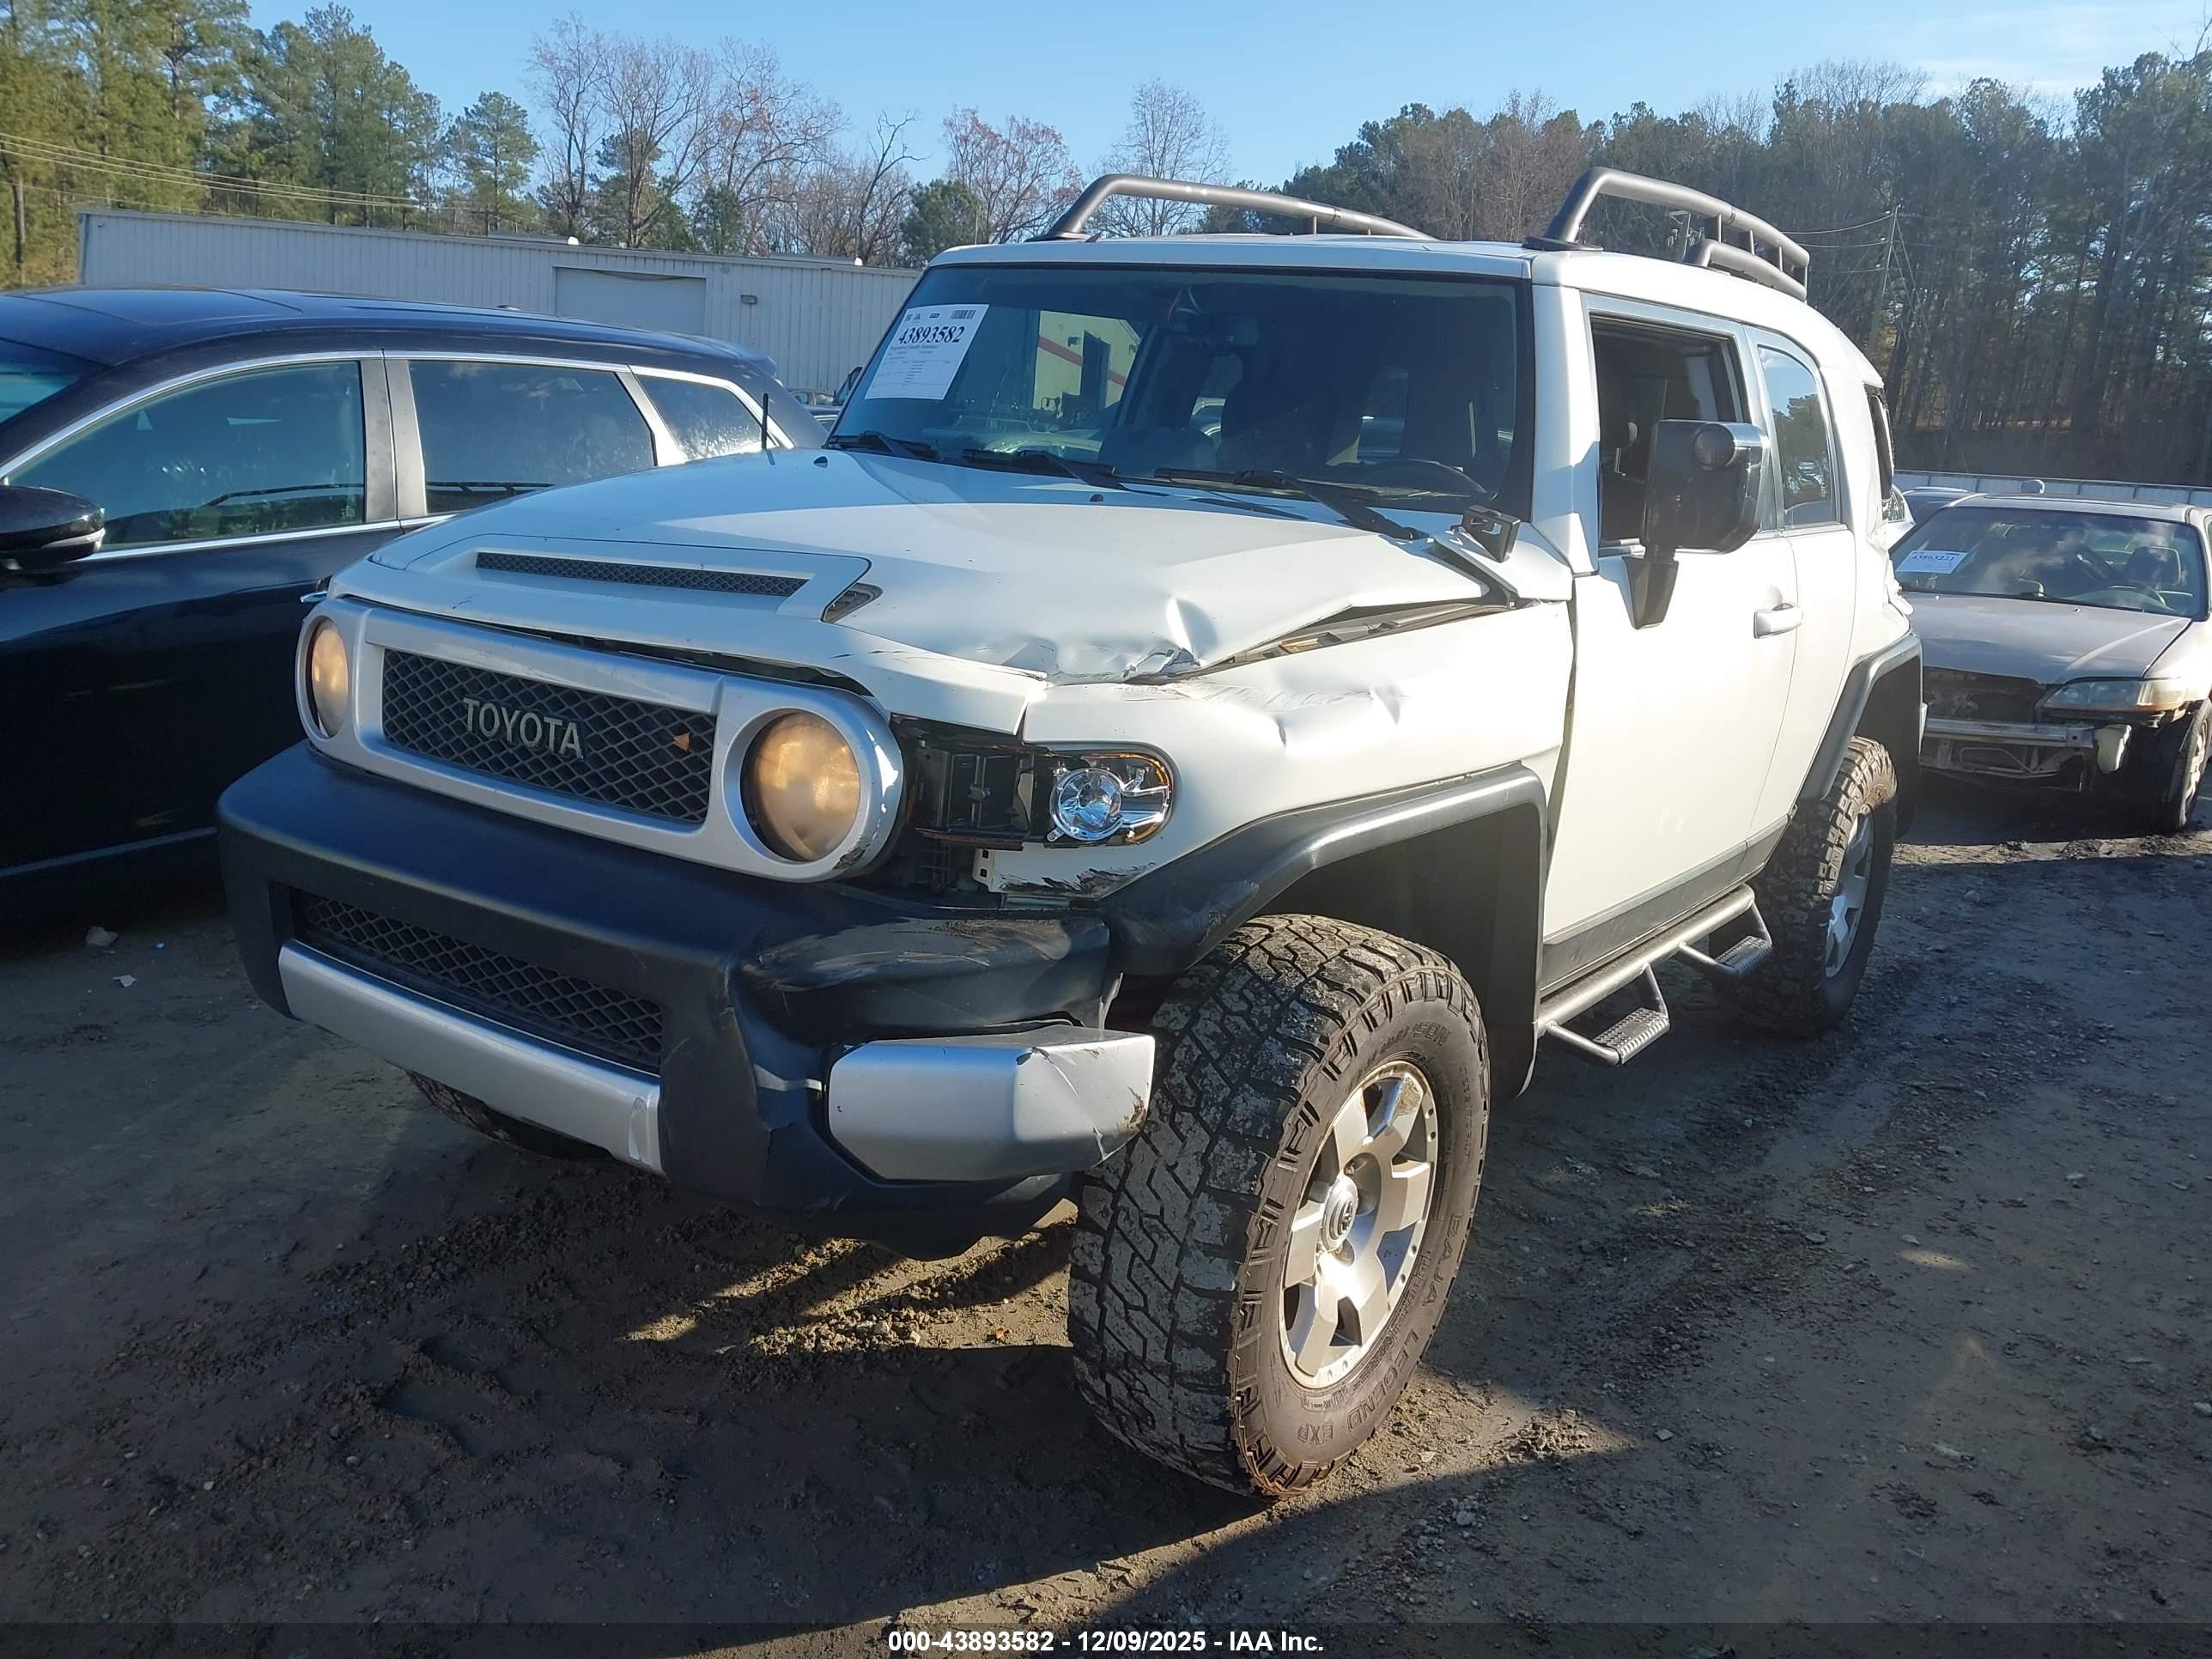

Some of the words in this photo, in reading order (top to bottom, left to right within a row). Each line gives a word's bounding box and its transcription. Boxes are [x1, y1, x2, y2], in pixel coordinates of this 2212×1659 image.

[898, 325, 965, 344] 43893582
[462, 696, 584, 761] TOYOTA
[1422, 1213, 1462, 1307] BAJA
[1346, 1328, 1419, 1433] LEGEND
[1297, 1422, 1334, 1446] EXP
